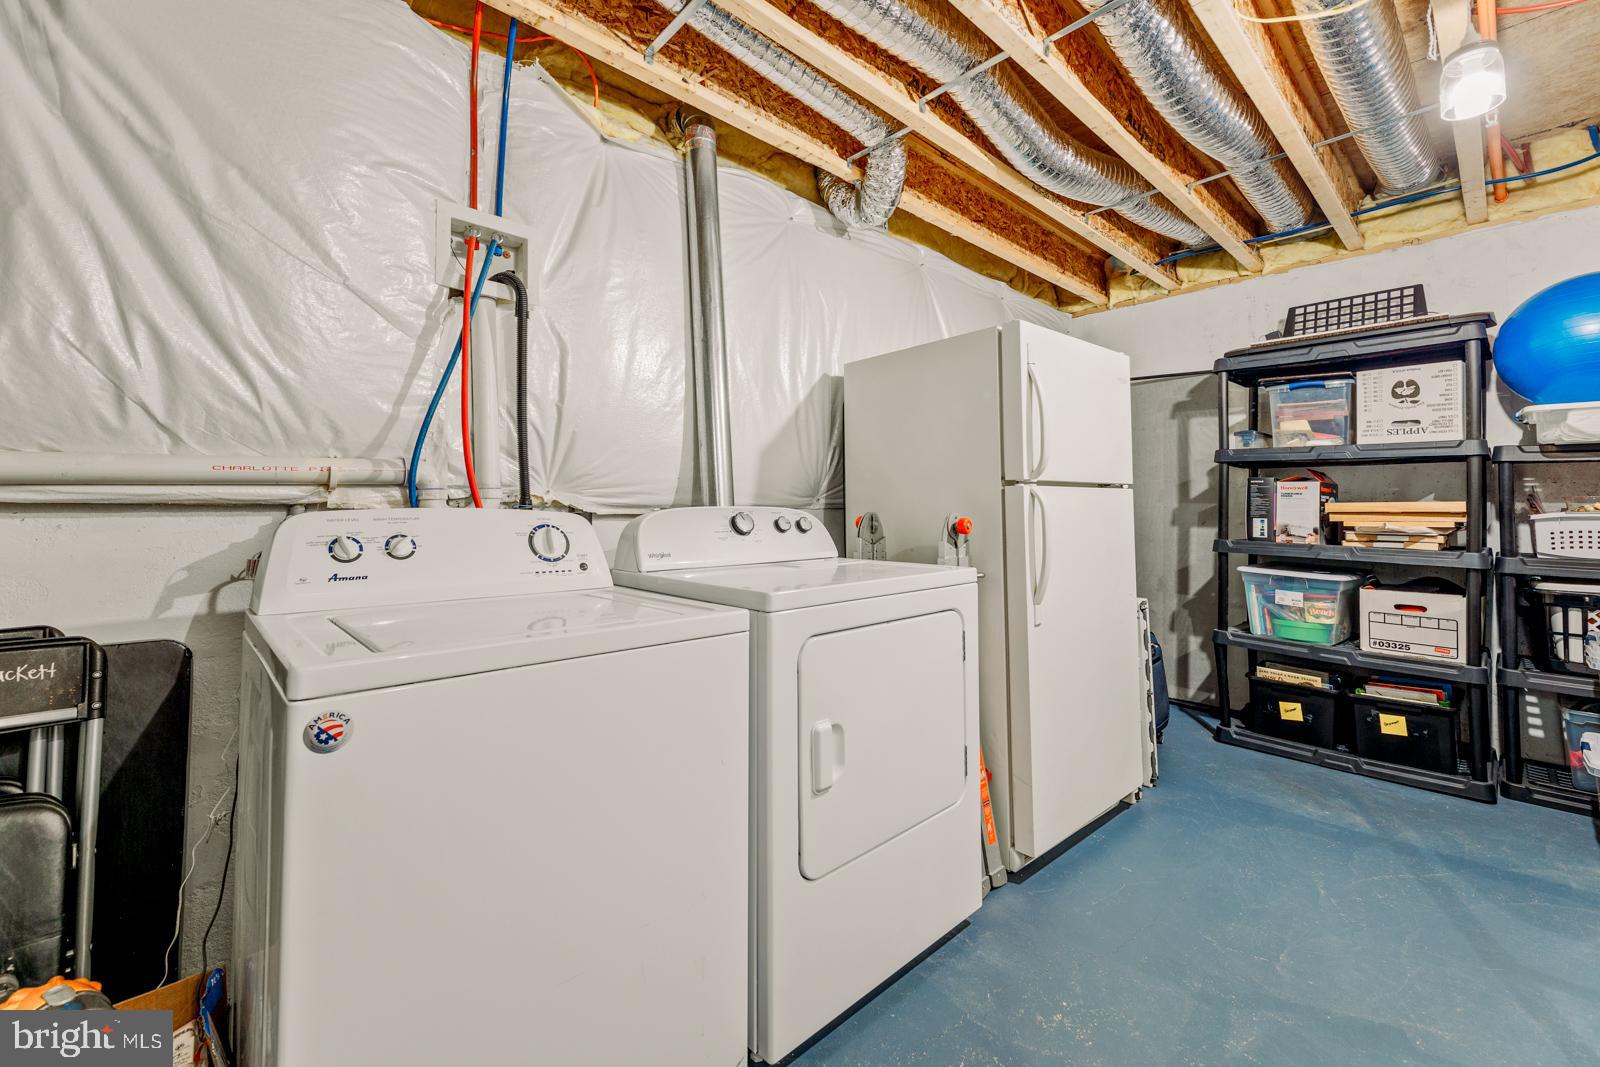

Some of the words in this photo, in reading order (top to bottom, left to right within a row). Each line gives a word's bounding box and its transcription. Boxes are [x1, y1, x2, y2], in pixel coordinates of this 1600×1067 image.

[1386, 426, 1429, 437] APPLES
[327, 572, 369, 583] Amana
[1372, 640, 1411, 651] #03325
[308, 711, 351, 731] AMERICA
